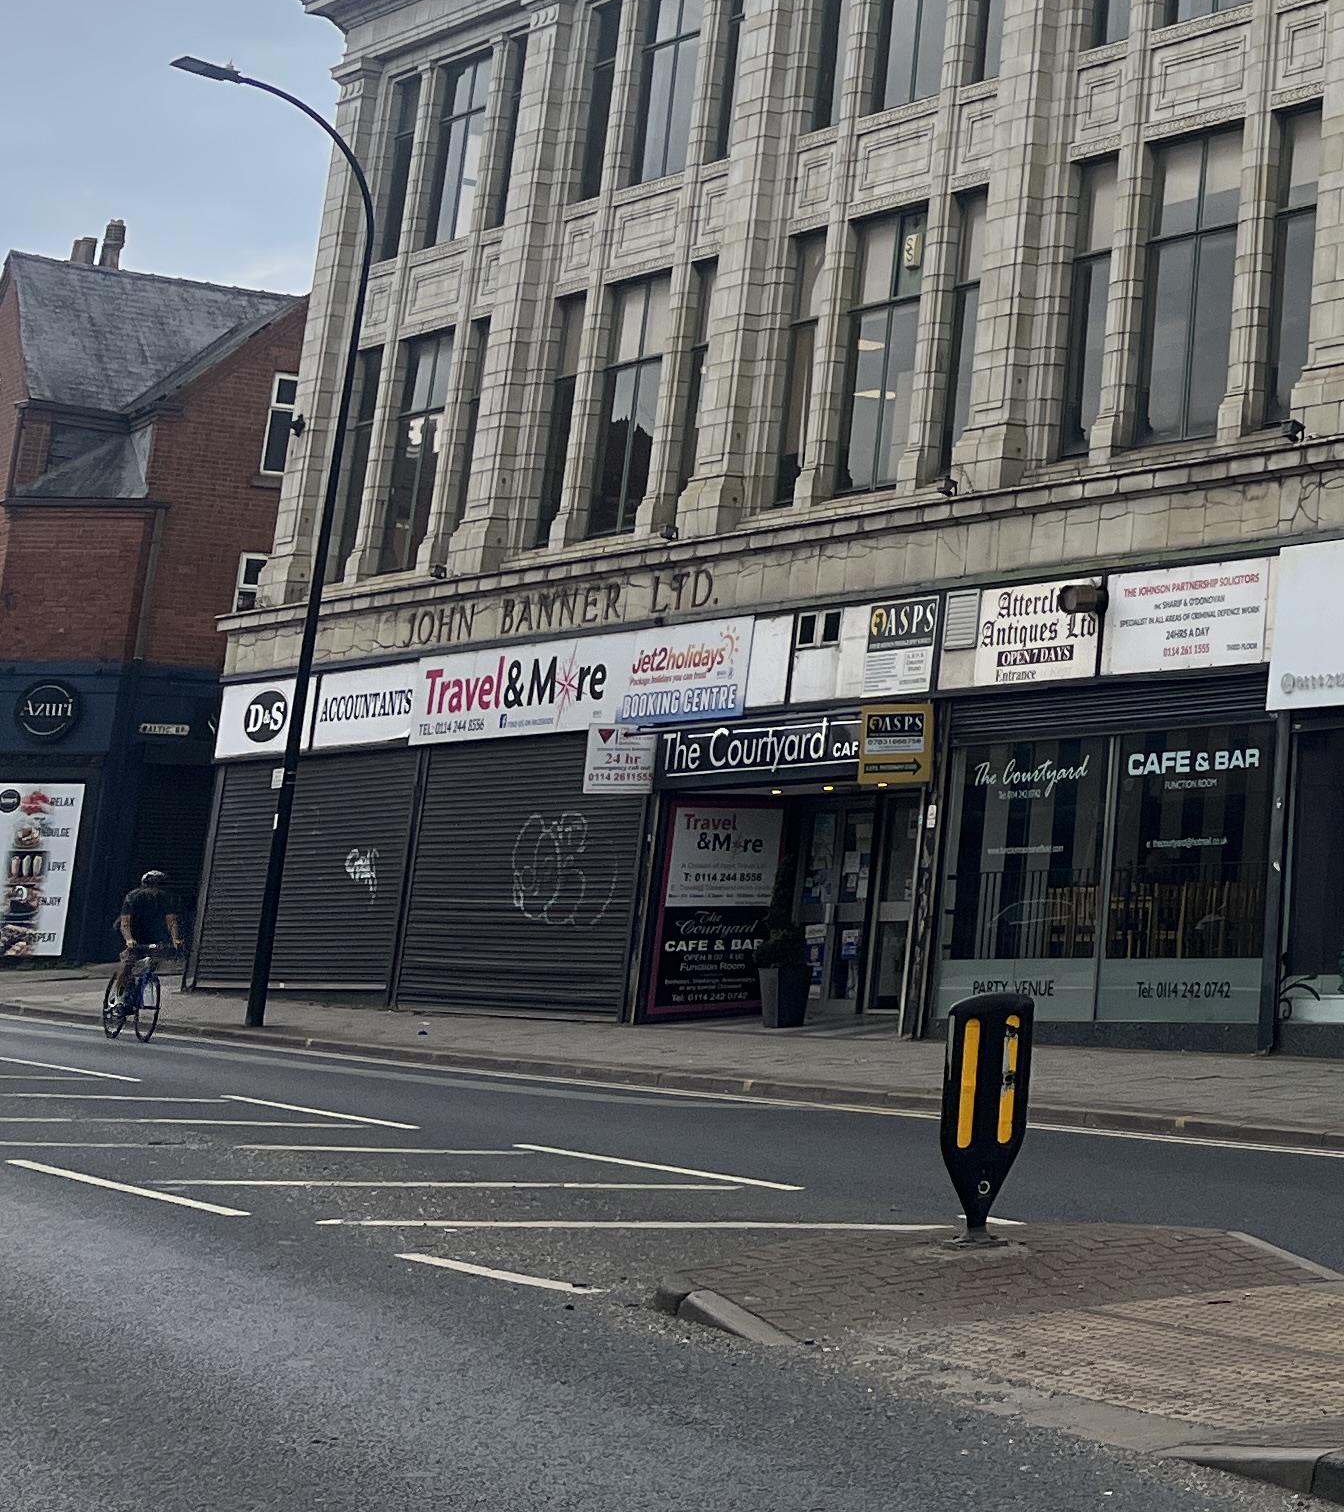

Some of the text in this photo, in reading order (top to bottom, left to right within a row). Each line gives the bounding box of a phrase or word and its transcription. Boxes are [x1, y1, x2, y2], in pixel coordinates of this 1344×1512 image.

[1124, 573, 1260, 598] THE JOHNSON PARTNERSHIP SOLICITORS
[401, 568, 719, 646] JOHN BANNER LTD.
[997, 587, 1061, 619] Attercli
[884, 602, 936, 637] ASPS
[980, 612, 1096, 648] Antiques Ltd
[632, 643, 726, 673] jet2holidays
[1001, 645, 1070, 666] OPEN 7 DAYS
[995, 669, 1036, 682] Entrance
[20, 699, 73, 716] Azuri
[319, 689, 413, 722] ACCOUNTANTS
[622, 684, 738, 719] BOOKING CENTRE
[246, 701, 285, 733] D&S
[881, 715, 923, 731] ASPS
[662, 731, 700, 770] The
[709, 717, 828, 773] Courtyard
[832, 741, 859, 757] CAF
[605, 753, 641, 764] 24 hr
[1127, 748, 1260, 776] CAFE & BAR
[974, 754, 1090, 798] The Courtyard
[683, 813, 738, 831] Travel
[694, 872, 717, 882] 0114
[719, 872, 737, 882] 244
[675, 919, 759, 938] Courtyard
[664, 939, 709, 952] CAFE
[713, 939, 725, 951] &
[972, 979, 1054, 996] PARTY VENUE
[1136, 981, 1231, 998] Tel: 0114 242 0742
